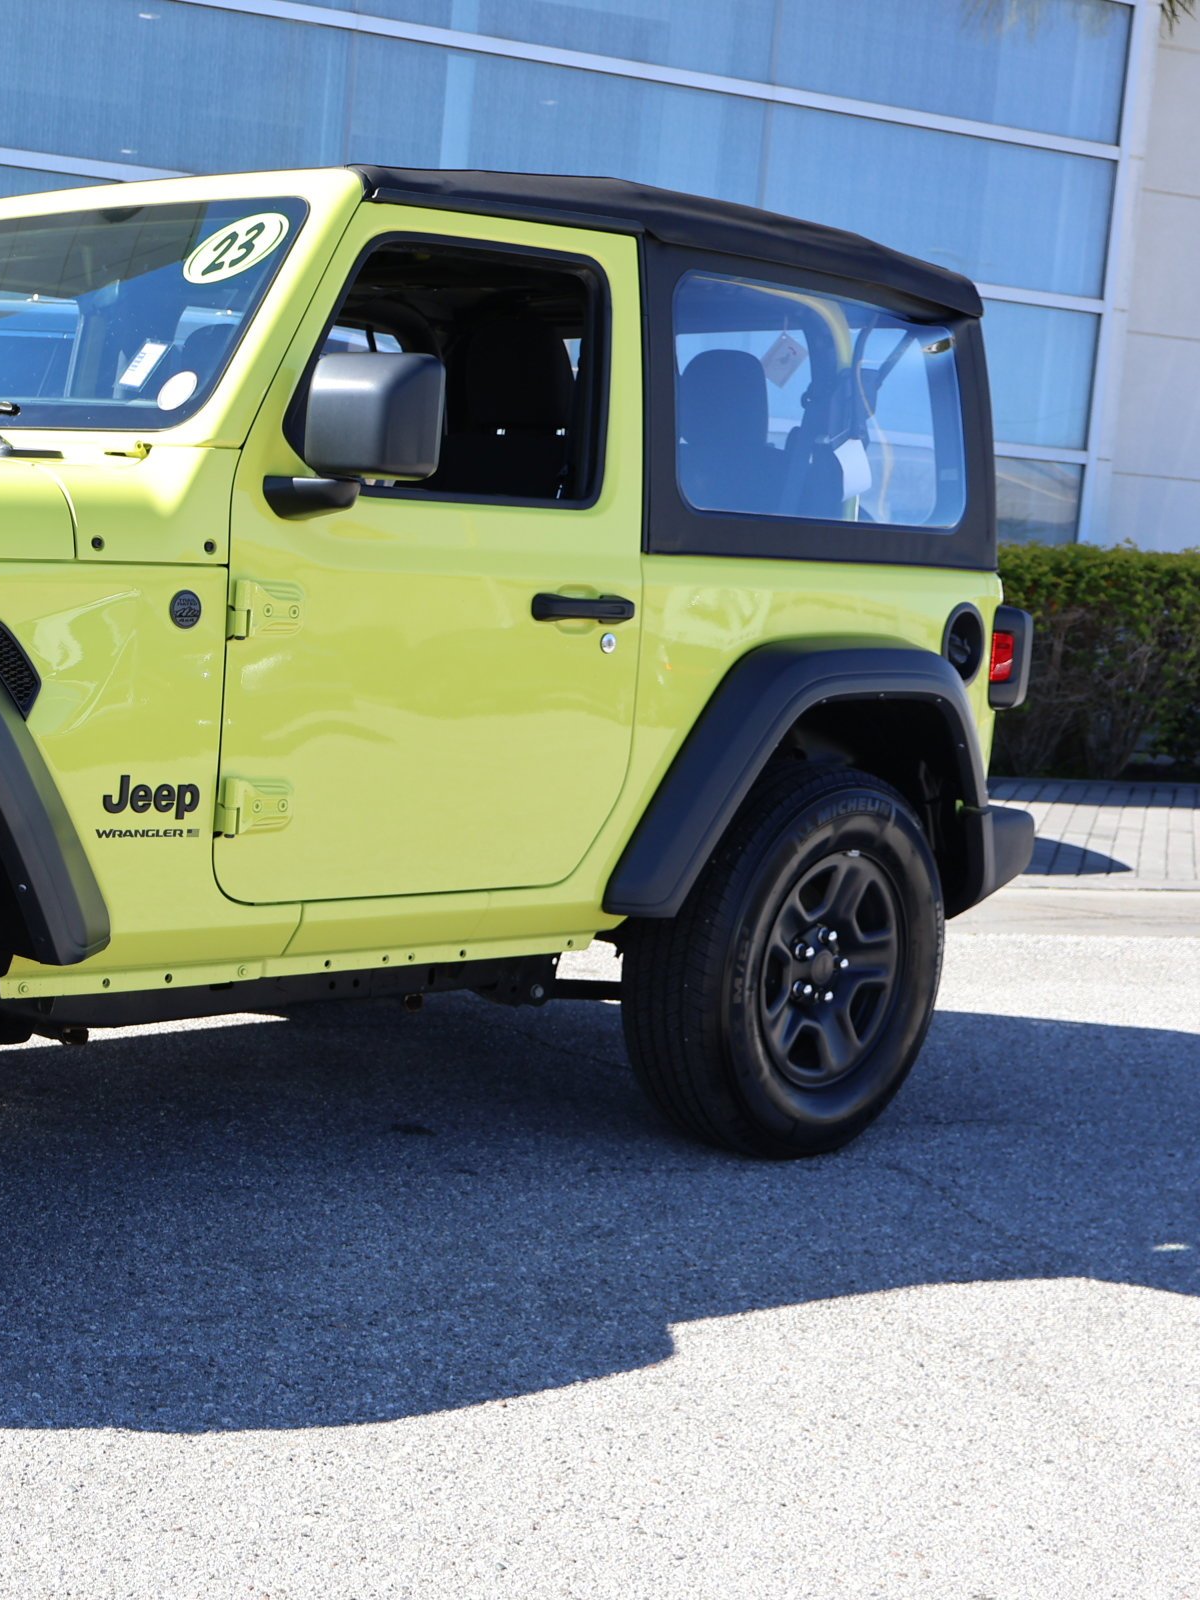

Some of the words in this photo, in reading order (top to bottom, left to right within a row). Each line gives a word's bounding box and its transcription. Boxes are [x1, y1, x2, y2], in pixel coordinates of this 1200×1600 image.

[201, 222, 265, 276] 23
[102, 774, 200, 820] Jeep
[816, 795, 891, 827] MICHELIN
[95, 828, 184, 839] WRANGLER
